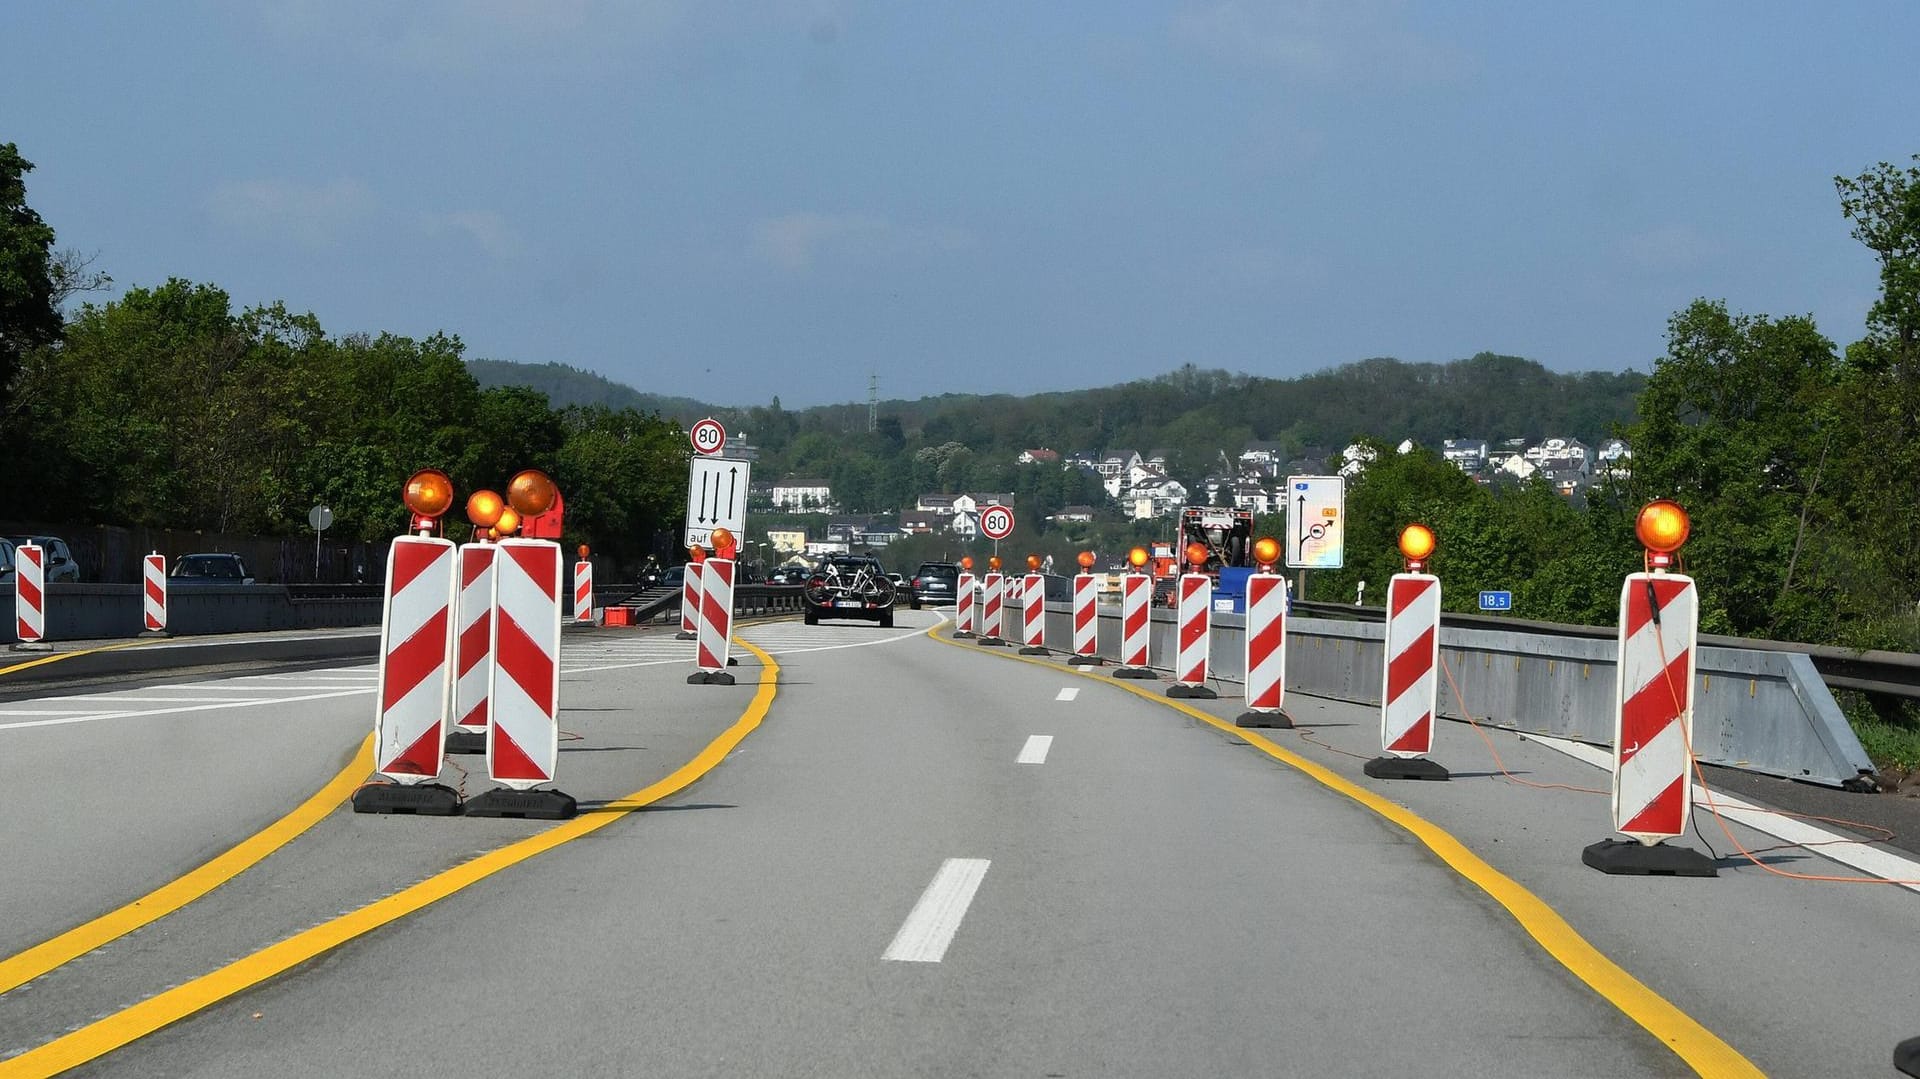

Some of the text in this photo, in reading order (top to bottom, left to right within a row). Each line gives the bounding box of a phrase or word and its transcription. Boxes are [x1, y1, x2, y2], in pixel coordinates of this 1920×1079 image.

[698, 428, 718, 444] 80
[988, 515, 1006, 530] 80
[690, 533, 708, 544] auf
